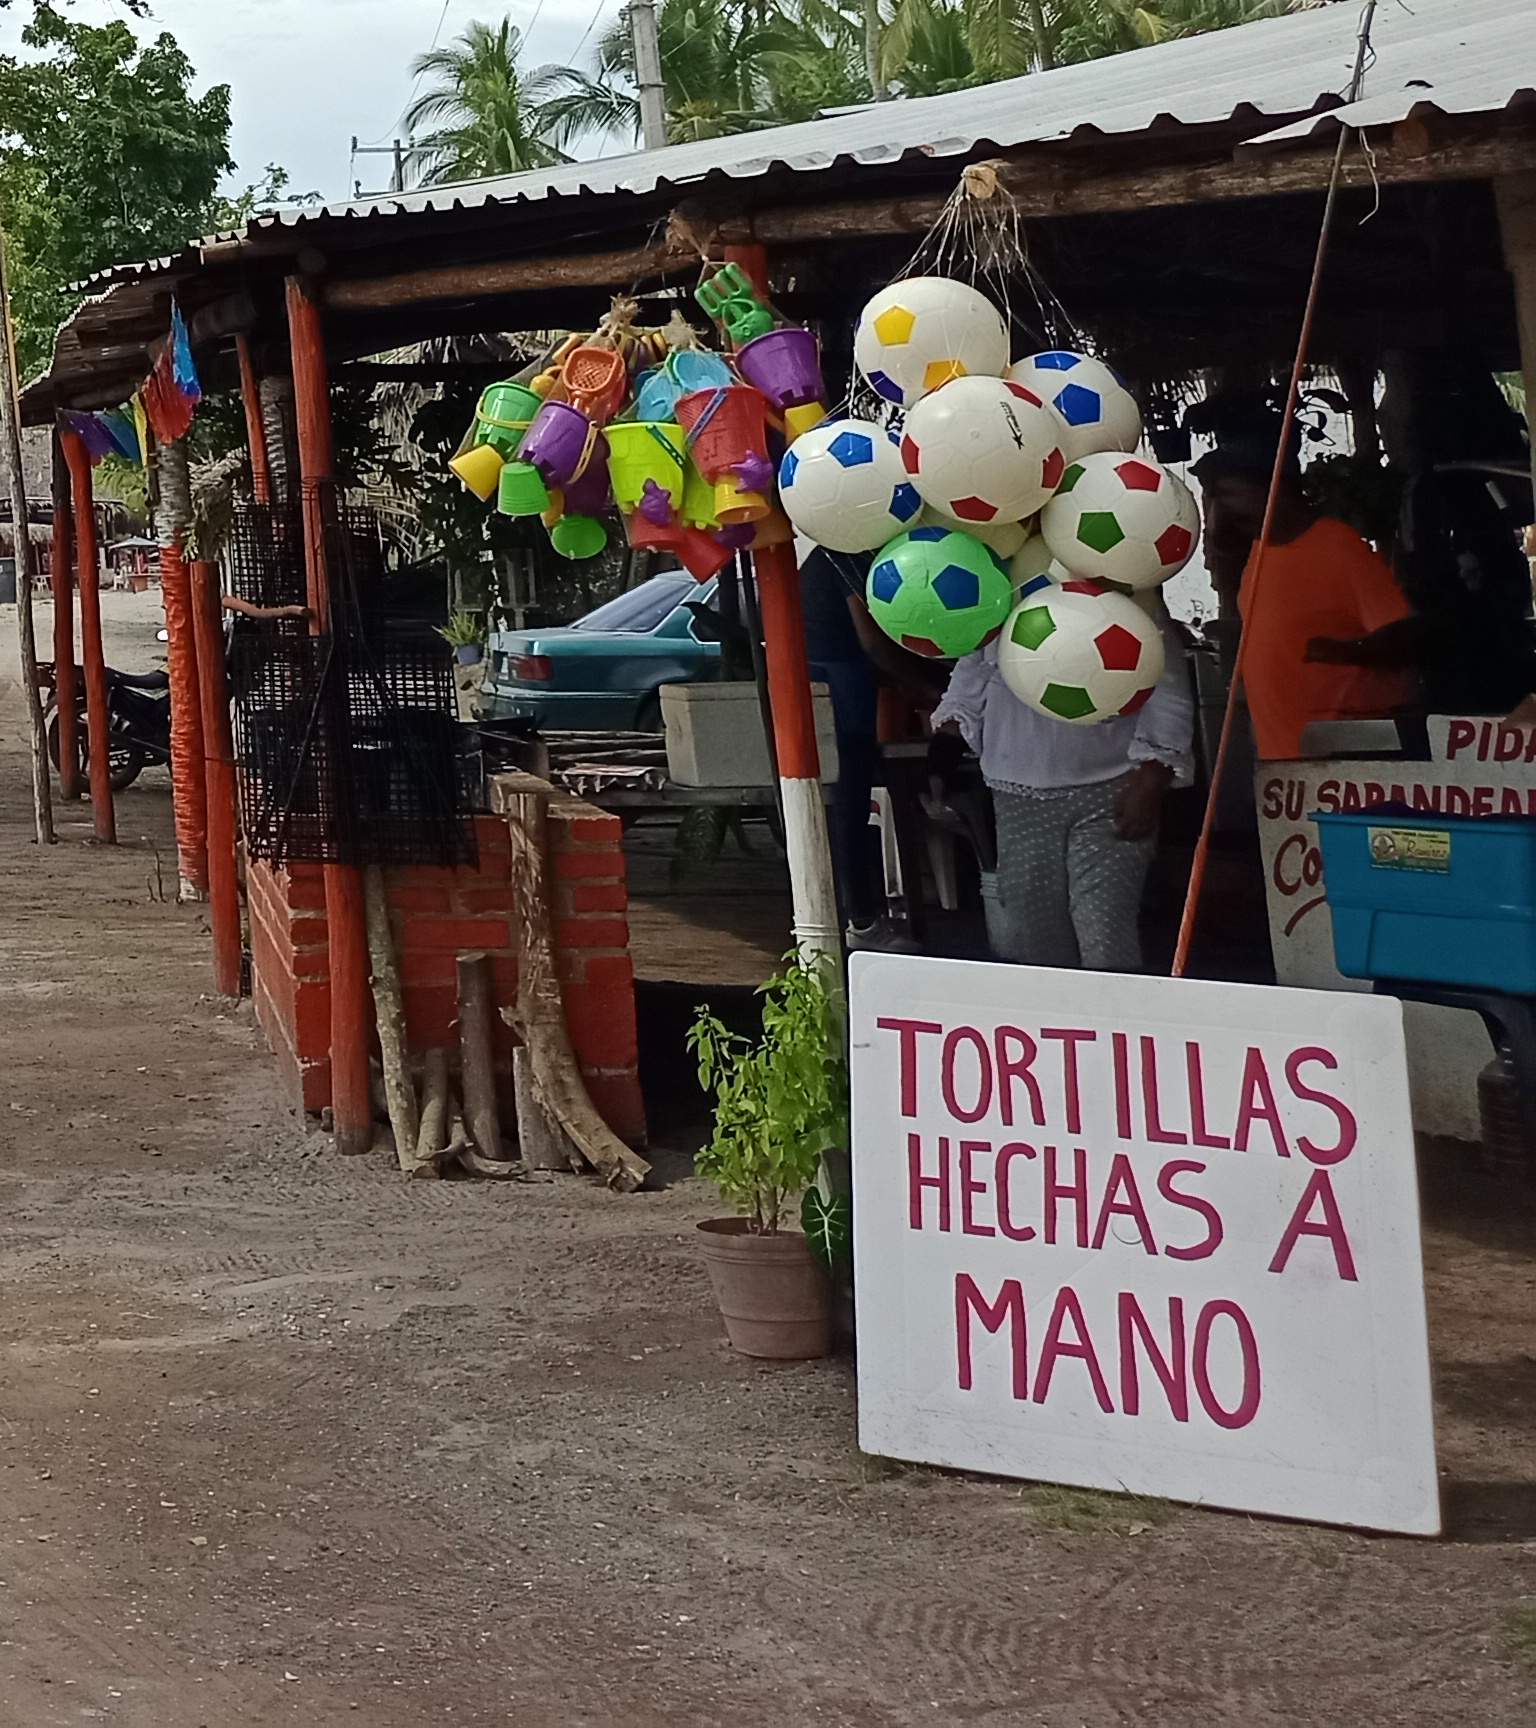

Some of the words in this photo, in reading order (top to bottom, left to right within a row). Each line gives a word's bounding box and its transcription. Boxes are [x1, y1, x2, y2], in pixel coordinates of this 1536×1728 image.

[1262, 778, 1306, 821] SU
[876, 1016, 1358, 1166] TORTILLAS
[907, 1132, 1225, 1262] HECHAS
[1268, 1169, 1359, 1282] A
[954, 1272, 1262, 1431] MANO
